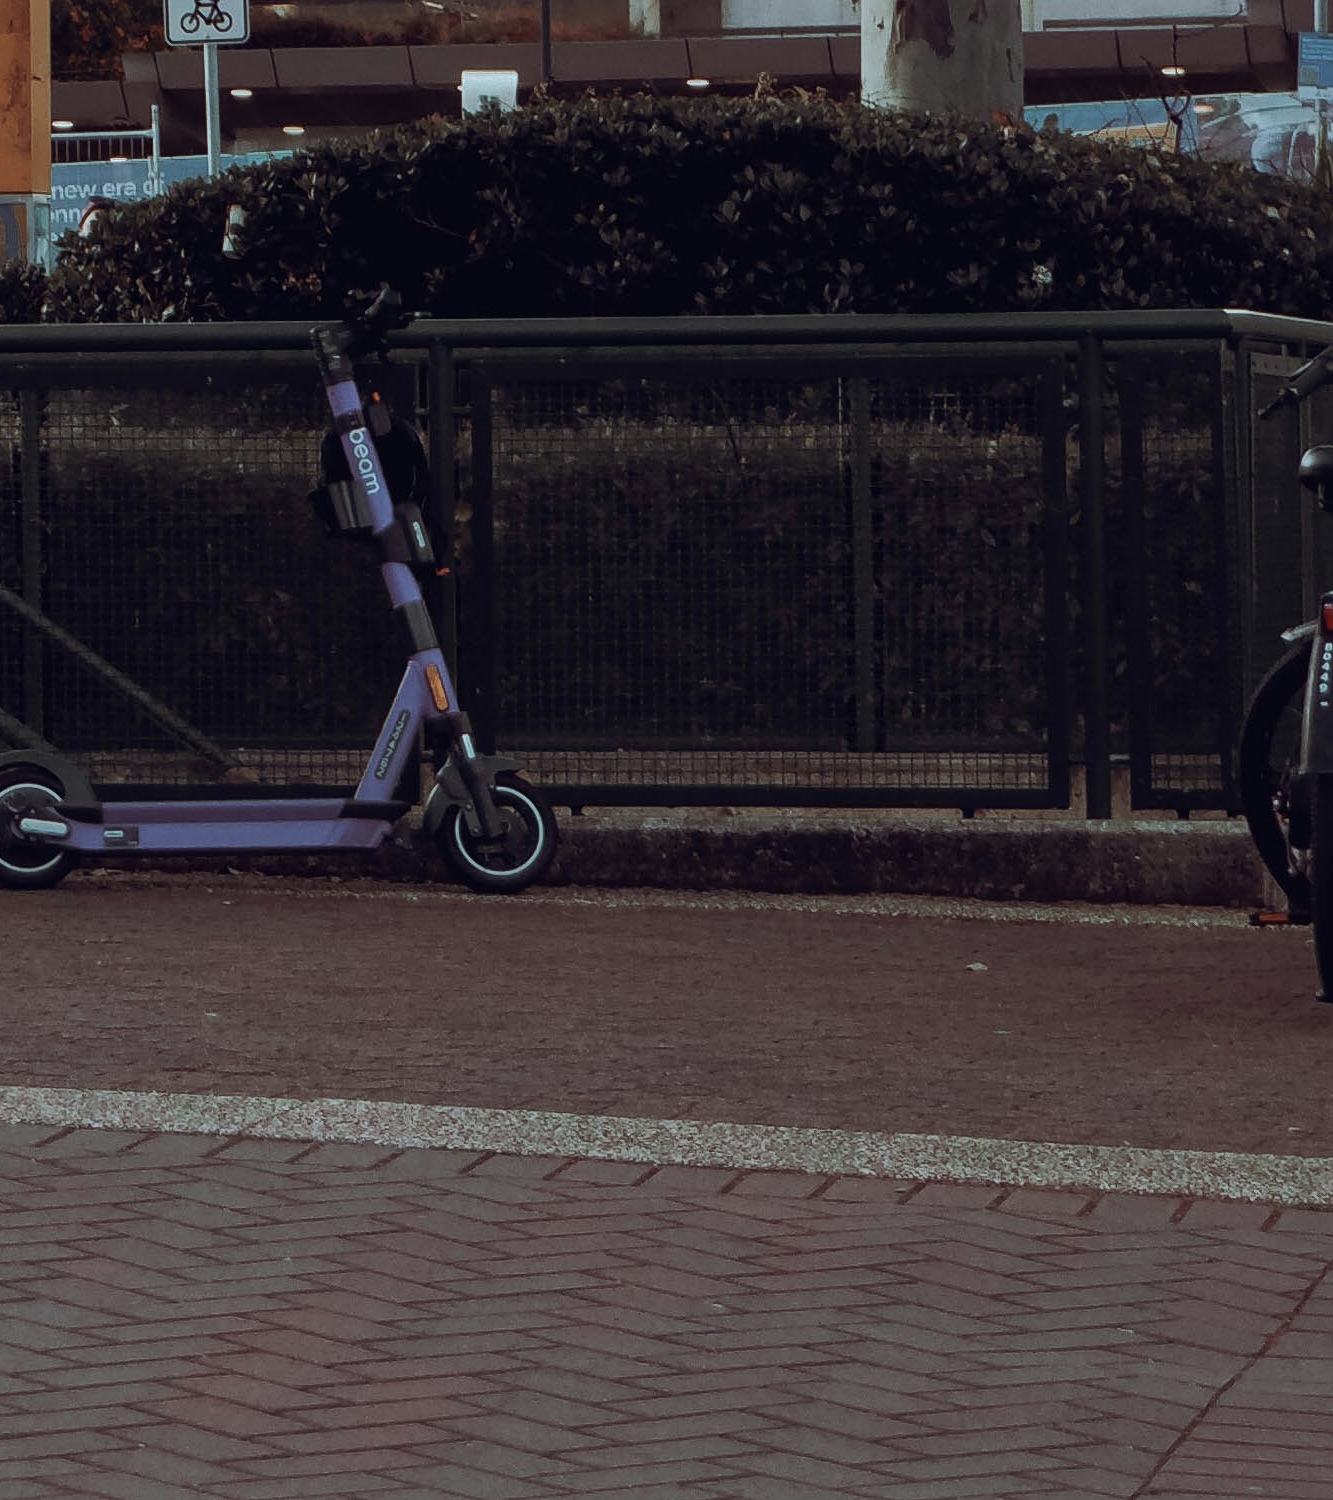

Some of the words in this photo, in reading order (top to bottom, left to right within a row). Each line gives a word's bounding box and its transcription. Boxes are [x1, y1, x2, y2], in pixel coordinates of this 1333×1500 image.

[51, 182, 97, 200] new
[102, 181, 137, 198] era
[349, 427, 381, 495] beam
